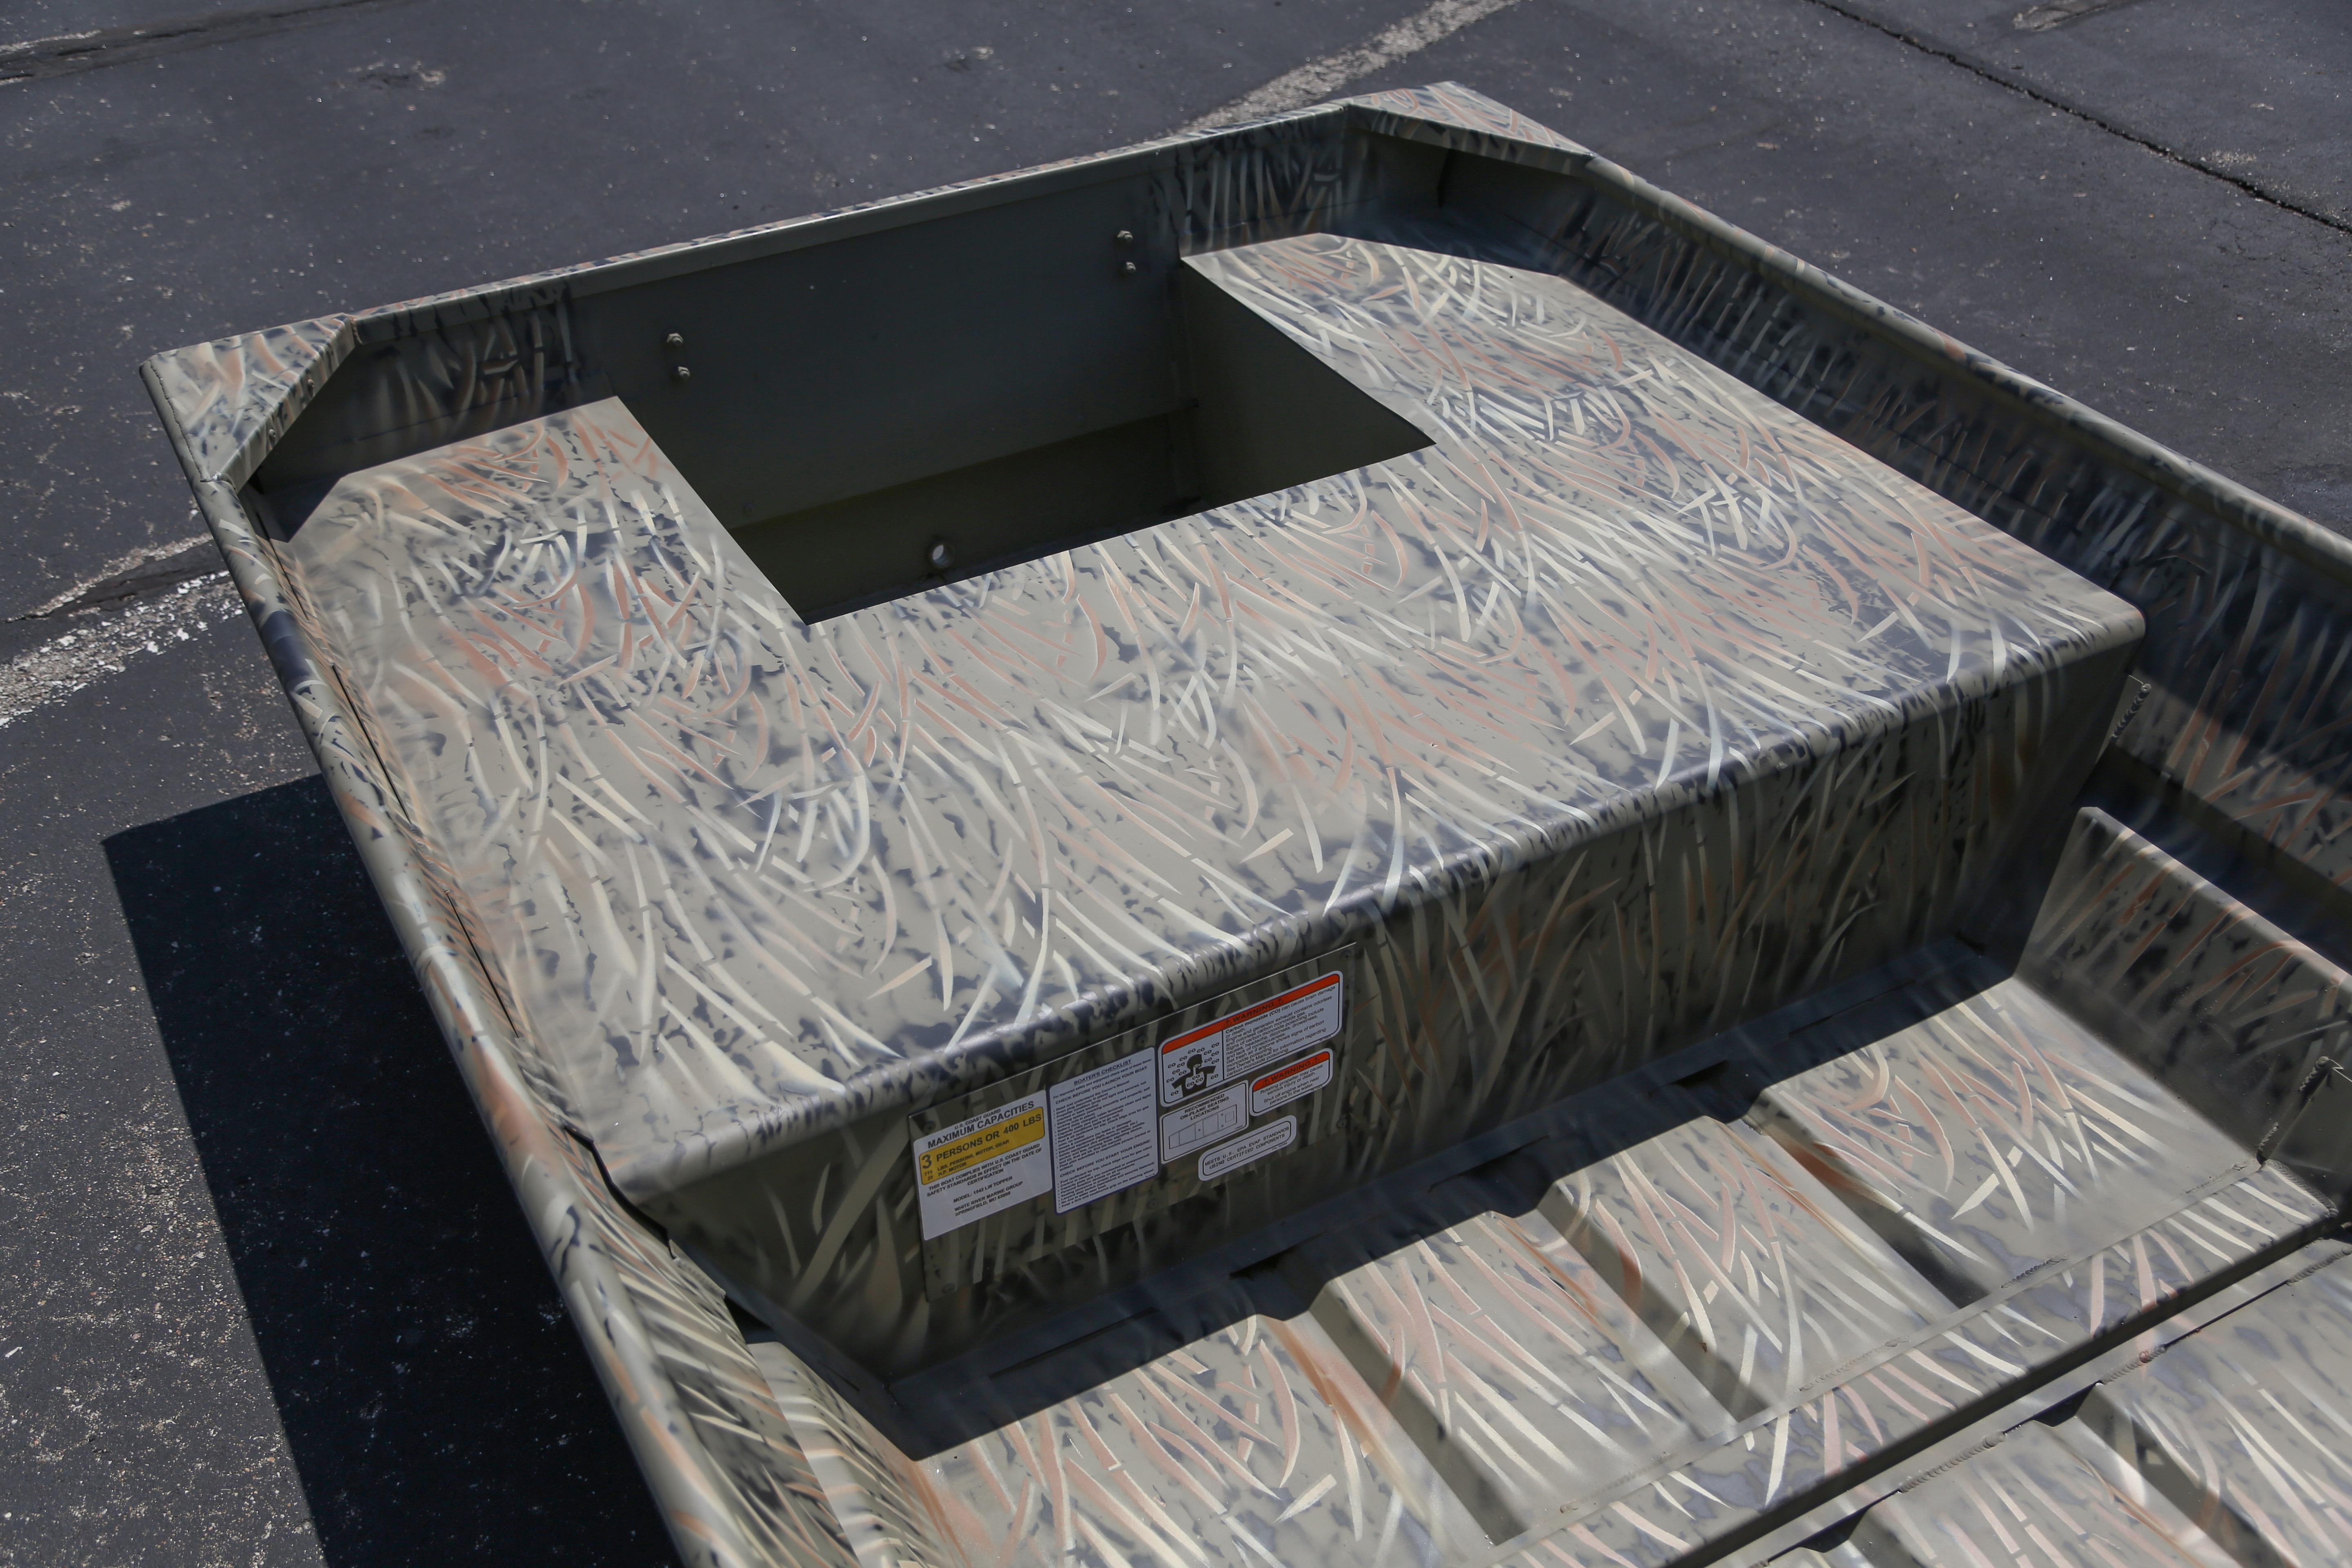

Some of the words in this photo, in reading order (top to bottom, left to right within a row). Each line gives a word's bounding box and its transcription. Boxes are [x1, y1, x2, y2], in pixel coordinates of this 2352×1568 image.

[1225, 1024, 1244, 1034] Carbon
[1244, 1013, 1268, 1026] monoxide
[1269, 1008, 1281, 1017] (CO)
[1290, 999, 1304, 1007] cause
[1317, 986, 1335, 996] damage
[1226, 1033, 1242, 1043] Engine
[1252, 1020, 1274, 1033] generator
[1275, 1011, 1293, 1022] exhaust
[1293, 1004, 1312, 1014] contains
[1313, 996, 1332, 1006] odorless
[1232, 1002, 1274, 1022] WARNING
[1226, 1043, 1239, 1051] Signs
[1245, 1033, 1261, 1043] carbon
[1262, 1024, 1285, 1036] monoxide
[1285, 1014, 1307, 1027] poisoning
[1307, 1007, 1324, 1017] include
[1231, 1028, 1246, 1036] death.
[1252, 1033, 1286, 1049] consciousness.
[1258, 1041, 1275, 1051] anyone
[1276, 1034, 1290, 1043] shows
[1309, 1020, 1325, 1029] carbon
[1236, 1058, 1255, 1068] Owner's
[1255, 1050, 1272, 1060] Manual
[1279, 1037, 1304, 1050] information
[1305, 1027, 1326, 1039] regarding
[1101, 1059, 1131, 1074] CHECKLIST
[1260, 1084, 1278, 1094] Rotating
[1279, 1075, 1298, 1087] propeller
[1310, 1064, 1323, 1072] cause
[1271, 1062, 1310, 1081] WARNING
[1267, 1086, 1283, 1096] serious
[1284, 1080, 1296, 1088] injury
[1302, 1072, 1316, 1080] death.
[1281, 1086, 1296, 1096] engine
[1180, 1106, 1206, 1120] ON-PLANE
[1207, 1096, 1229, 1108] SEATING
[1184, 1094, 1225, 1114] RECOMMENDED
[1190, 1105, 1219, 1120] LOCATIONS
[1270, 1094, 1287, 1106] persons
[927, 1124, 975, 1149] MAXIMUM
[977, 1100, 1034, 1129] CAPACITIES
[965, 1116, 982, 1125] COAST
[983, 1108, 1001, 1118] GUARD
[921, 1154, 932, 1169] 3
[936, 1137, 983, 1162] PERSONS
[985, 1130, 1000, 1142] OR
[1003, 1122, 1019, 1134] 400
[1023, 1114, 1042, 1127] LBS
[949, 1154, 974, 1166] PERSONS,
[975, 1145, 994, 1156] MOTOR,
[995, 1139, 1009, 1148] GEAR
[1205, 1156, 1220, 1166] MEETS
[1249, 1138, 1261, 1147] EVAP
[1263, 1126, 1289, 1141] STANDARDS
[1209, 1159, 1225, 1169] USING
[1227, 1147, 1254, 1162] CERTIFIED
[1256, 1133, 1285, 1149] COMPONENTS
[927, 1186, 946, 1197] SAFETY
[947, 1174, 977, 1189] STANDARDS
[983, 1163, 1002, 1174] EFFECT
[1021, 1150, 1034, 1159] DATE
[940, 1177, 954, 1186] BOAT
[955, 1167, 980, 1180] COMPLIES
[981, 1161, 994, 1170] WITH
[1004, 1150, 1022, 1160] COAST
[1022, 1143, 1040, 1153] GUARD
[948, 1161, 967, 1172] MOTOR
[967, 1168, 1004, 1186] CERTIFICATION
[953, 1193, 973, 1203] MODEL:
[993, 1176, 1013, 1187] TOPPER
[954, 1202, 970, 1212] WHITE
[971, 1196, 985, 1205] RIVER
[986, 1188, 1004, 1199] MARINE
[1005, 1181, 1023, 1191] GROUP
